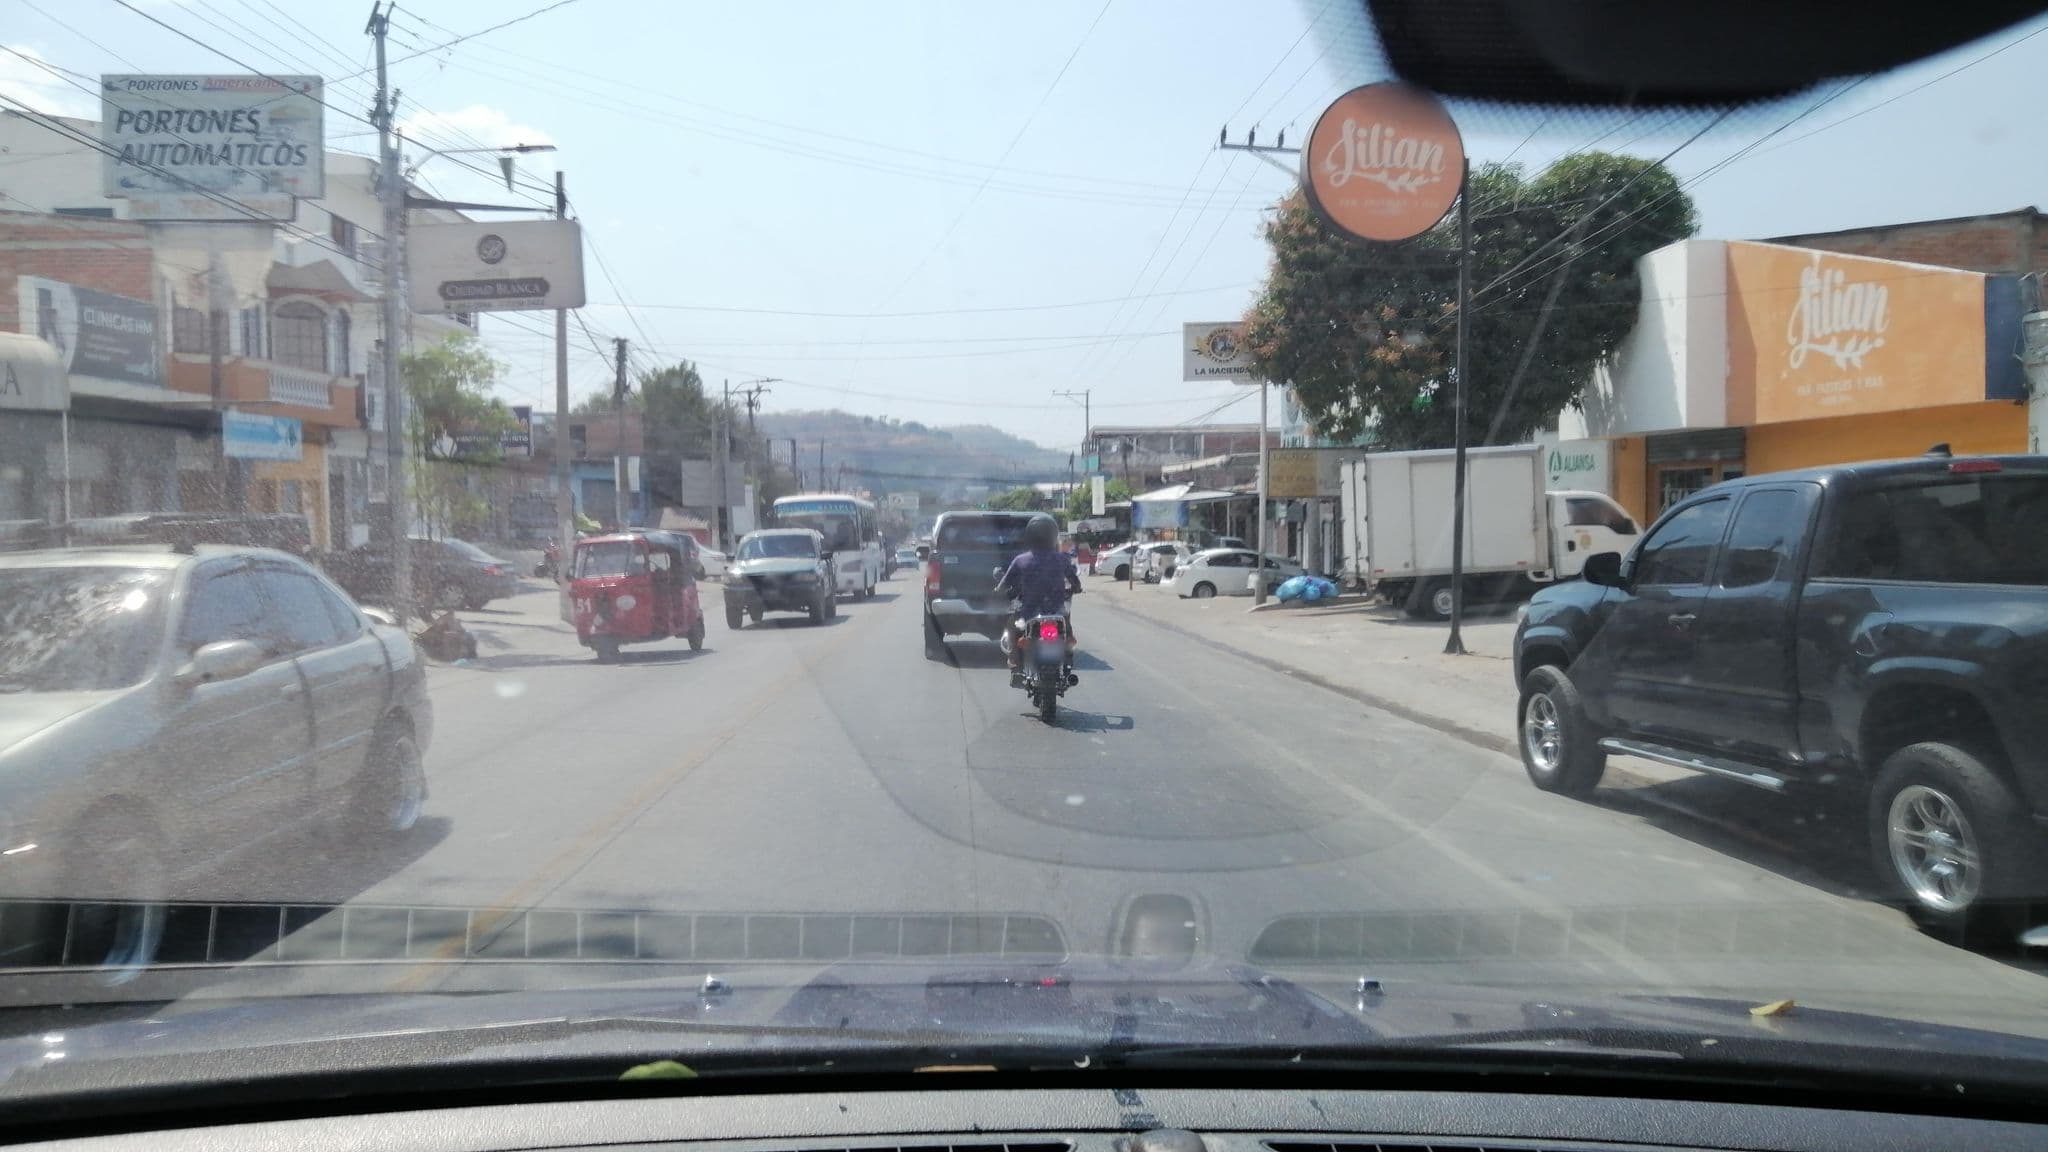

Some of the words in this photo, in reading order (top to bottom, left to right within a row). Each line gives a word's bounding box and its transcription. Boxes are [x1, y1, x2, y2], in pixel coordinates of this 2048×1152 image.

[128, 80, 198, 91] PORTONES
[116, 109, 261, 135] PORTONES
[120, 138, 308, 166] AUTOMÁTICOS
[496, 282, 540, 295] BLANCA
[1564, 453, 1595, 473] ALIANSA
